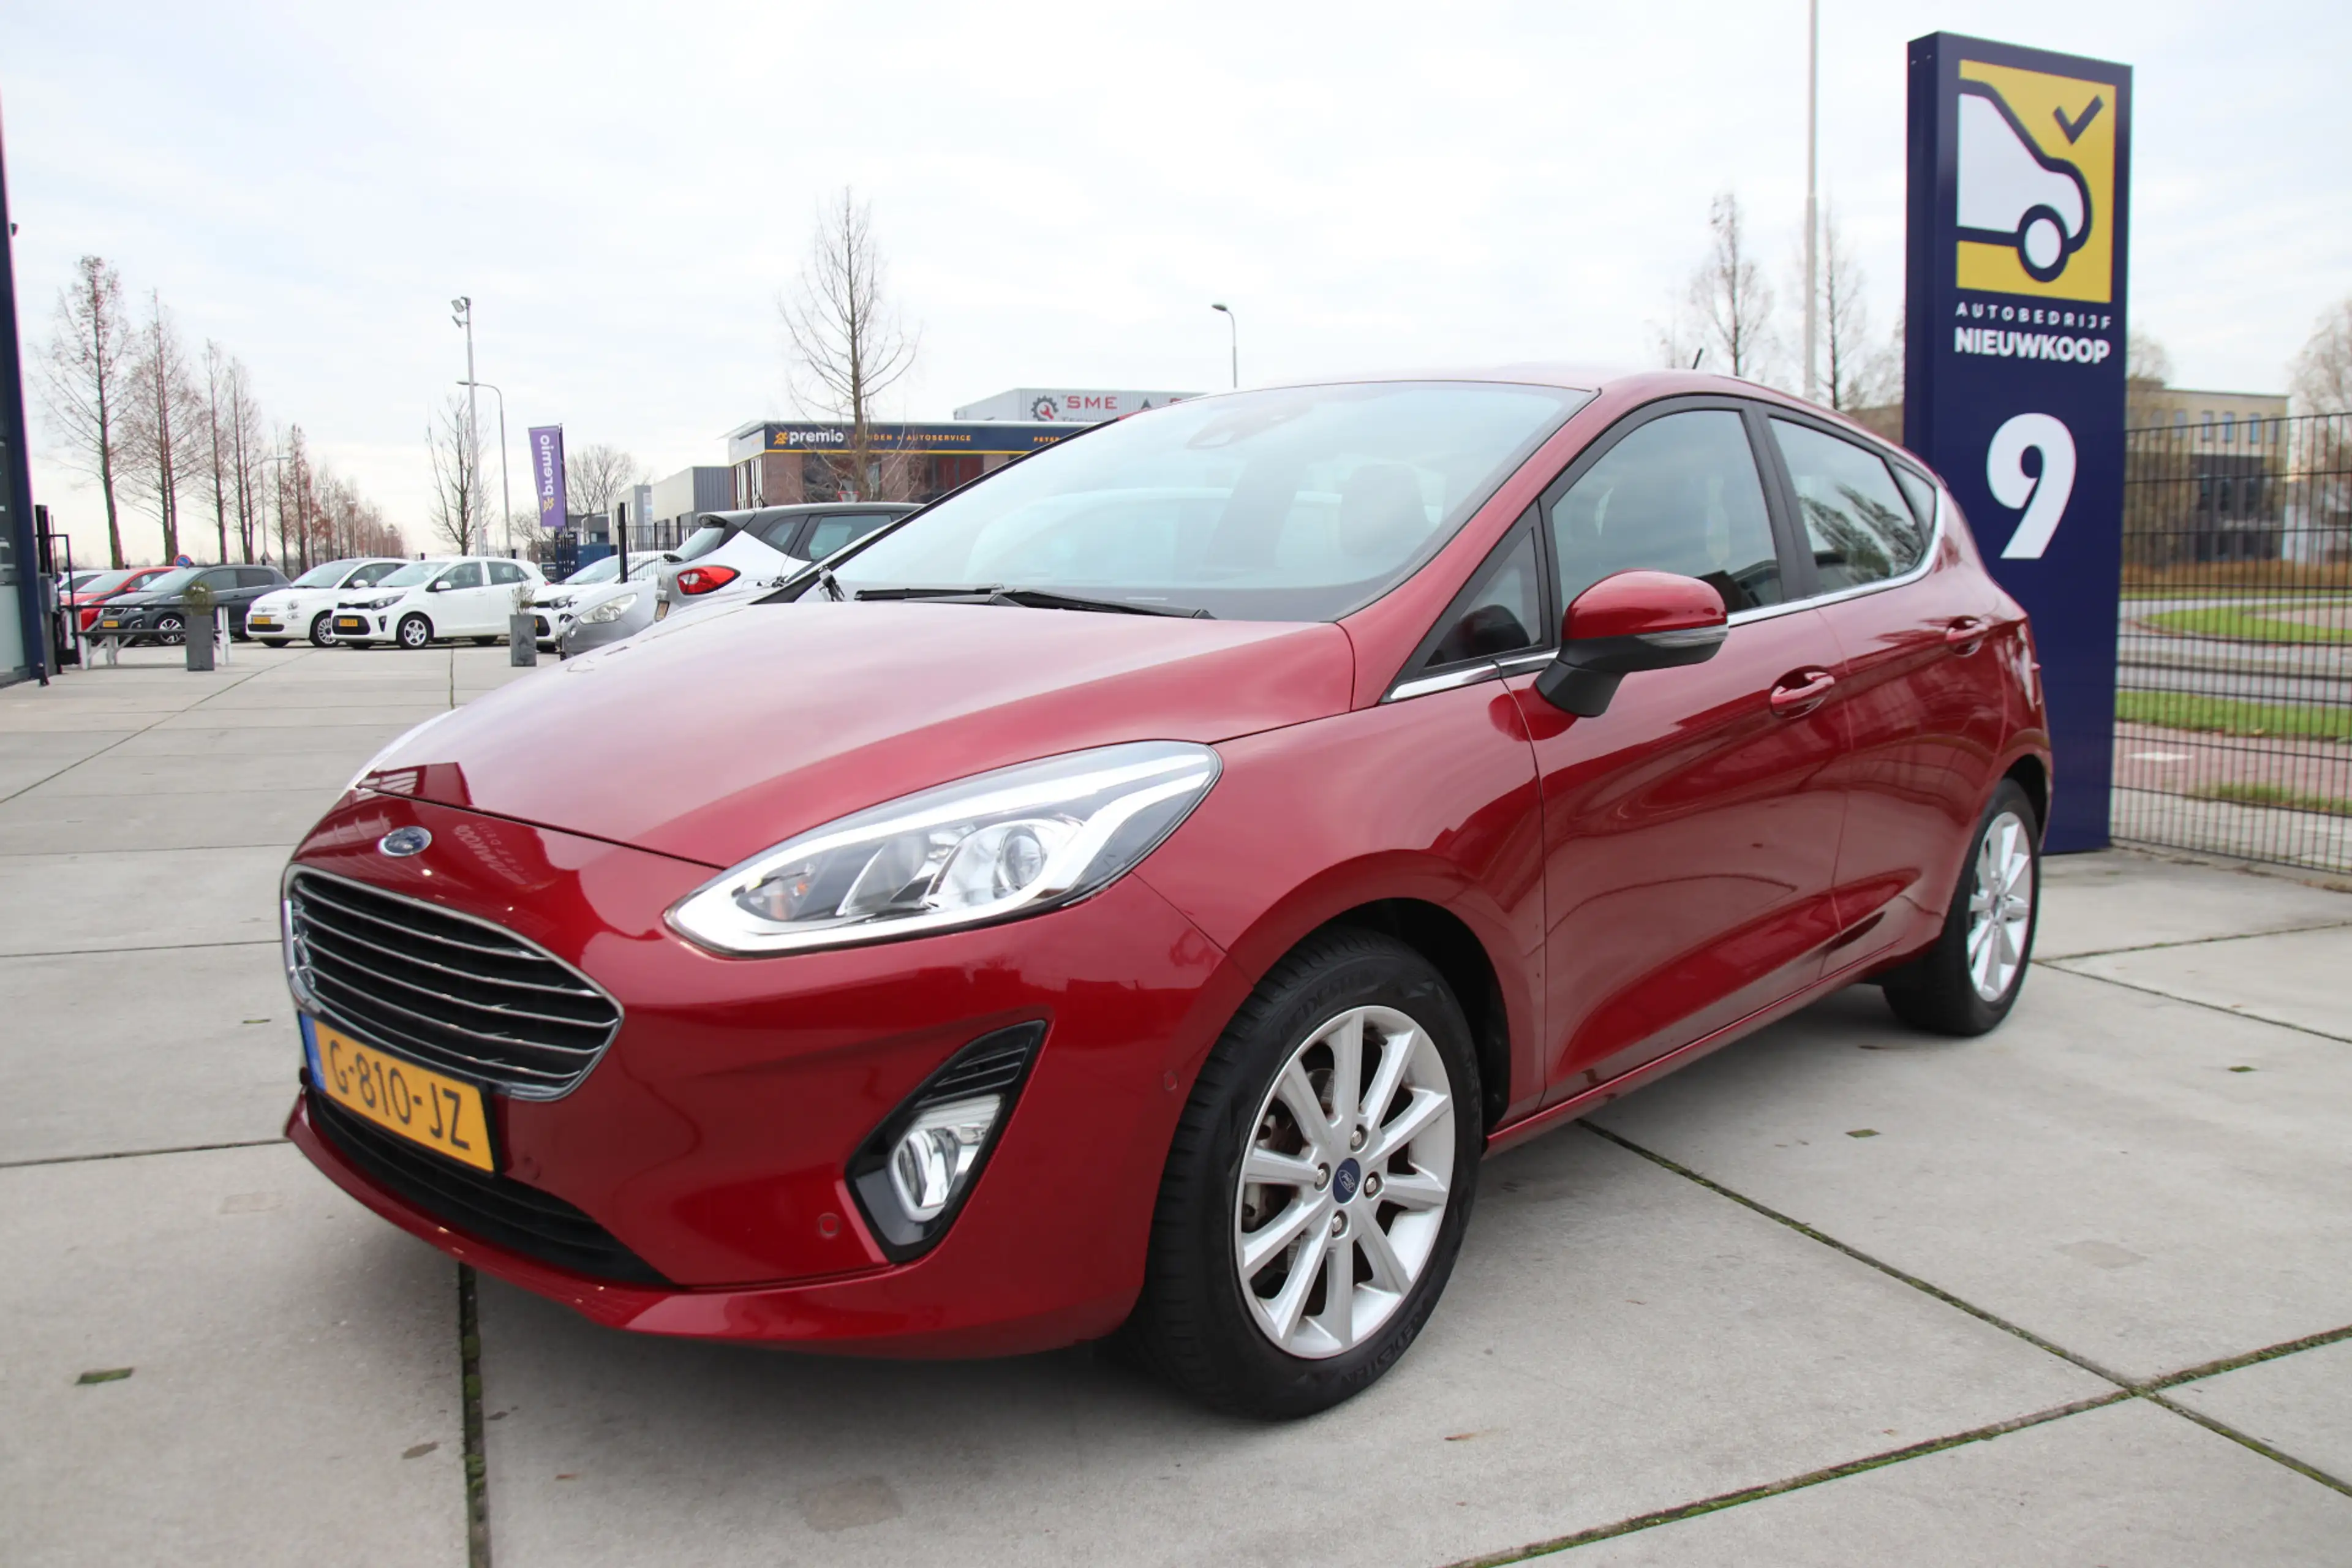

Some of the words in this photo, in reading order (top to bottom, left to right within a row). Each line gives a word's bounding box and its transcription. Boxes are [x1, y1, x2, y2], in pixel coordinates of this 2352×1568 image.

[1955, 301, 2111, 330] AUTOBEDRIJF
[1954, 326, 2111, 364] NIEUWKOOP
[1067, 395, 1118, 409] SME
[789, 429, 844, 445] premio
[1986, 413, 2076, 559] 9
[329, 1039, 471, 1150] G-810-JZ
